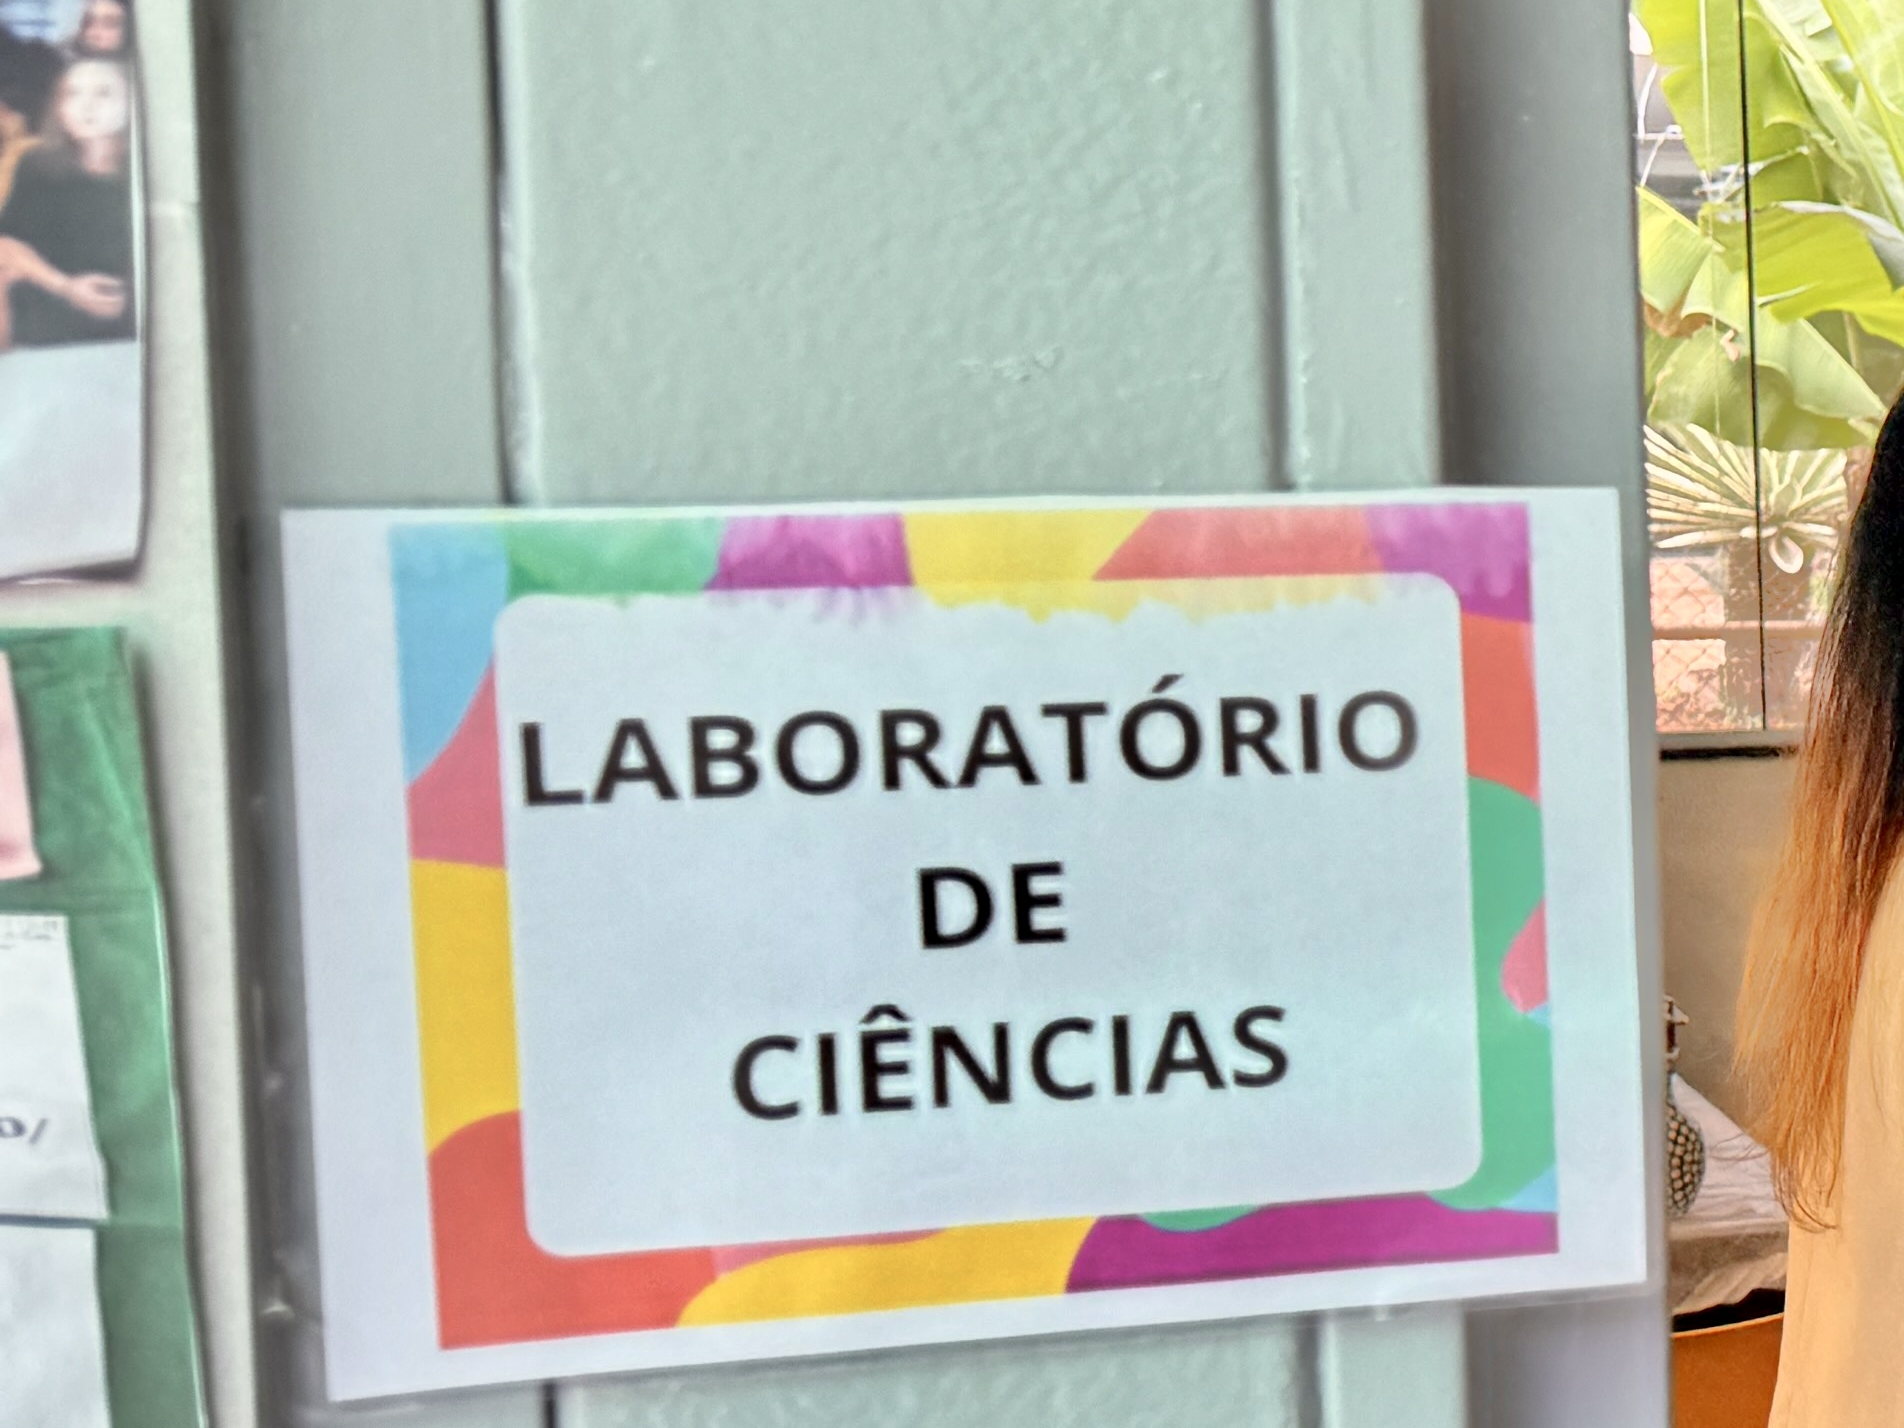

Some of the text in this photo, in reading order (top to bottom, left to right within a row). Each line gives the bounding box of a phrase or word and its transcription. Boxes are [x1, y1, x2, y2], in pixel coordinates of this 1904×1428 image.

[520, 672, 1417, 808] LABORATÓRIO
[917, 859, 1068, 952] DE
[731, 1002, 1290, 1122] CIÊNCIAS
